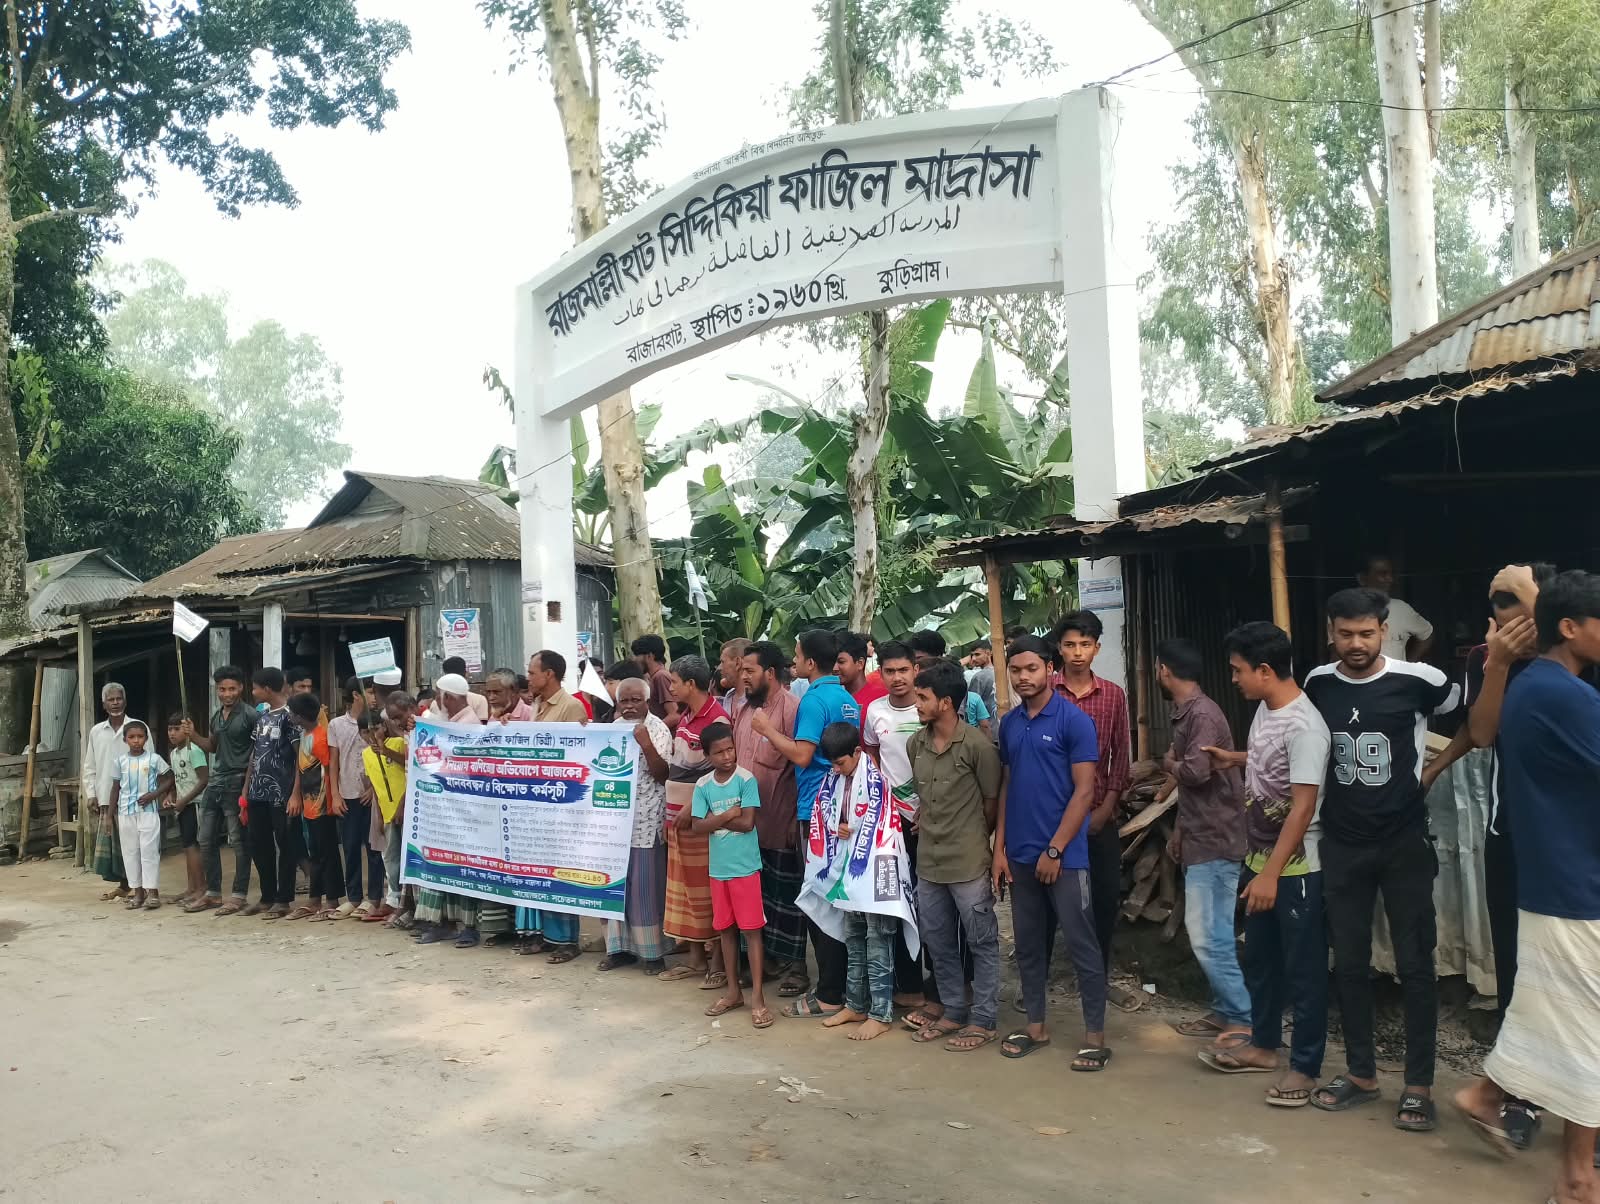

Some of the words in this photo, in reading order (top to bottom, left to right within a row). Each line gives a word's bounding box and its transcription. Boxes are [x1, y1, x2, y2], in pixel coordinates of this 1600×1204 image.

[657, 175, 773, 267] সিদ্দিকিয়া
[778, 148, 899, 212] ফাজিল
[903, 144, 1042, 201] মাদ্রাসা
[560, 736, 586, 748] মাদ্রাসা
[496, 760, 540, 777] অভিযোগে
[541, 766, 583, 779] আজকের
[492, 778, 528, 796] বিক্ষোভ
[531, 781, 568, 802] কর্মসূচী
